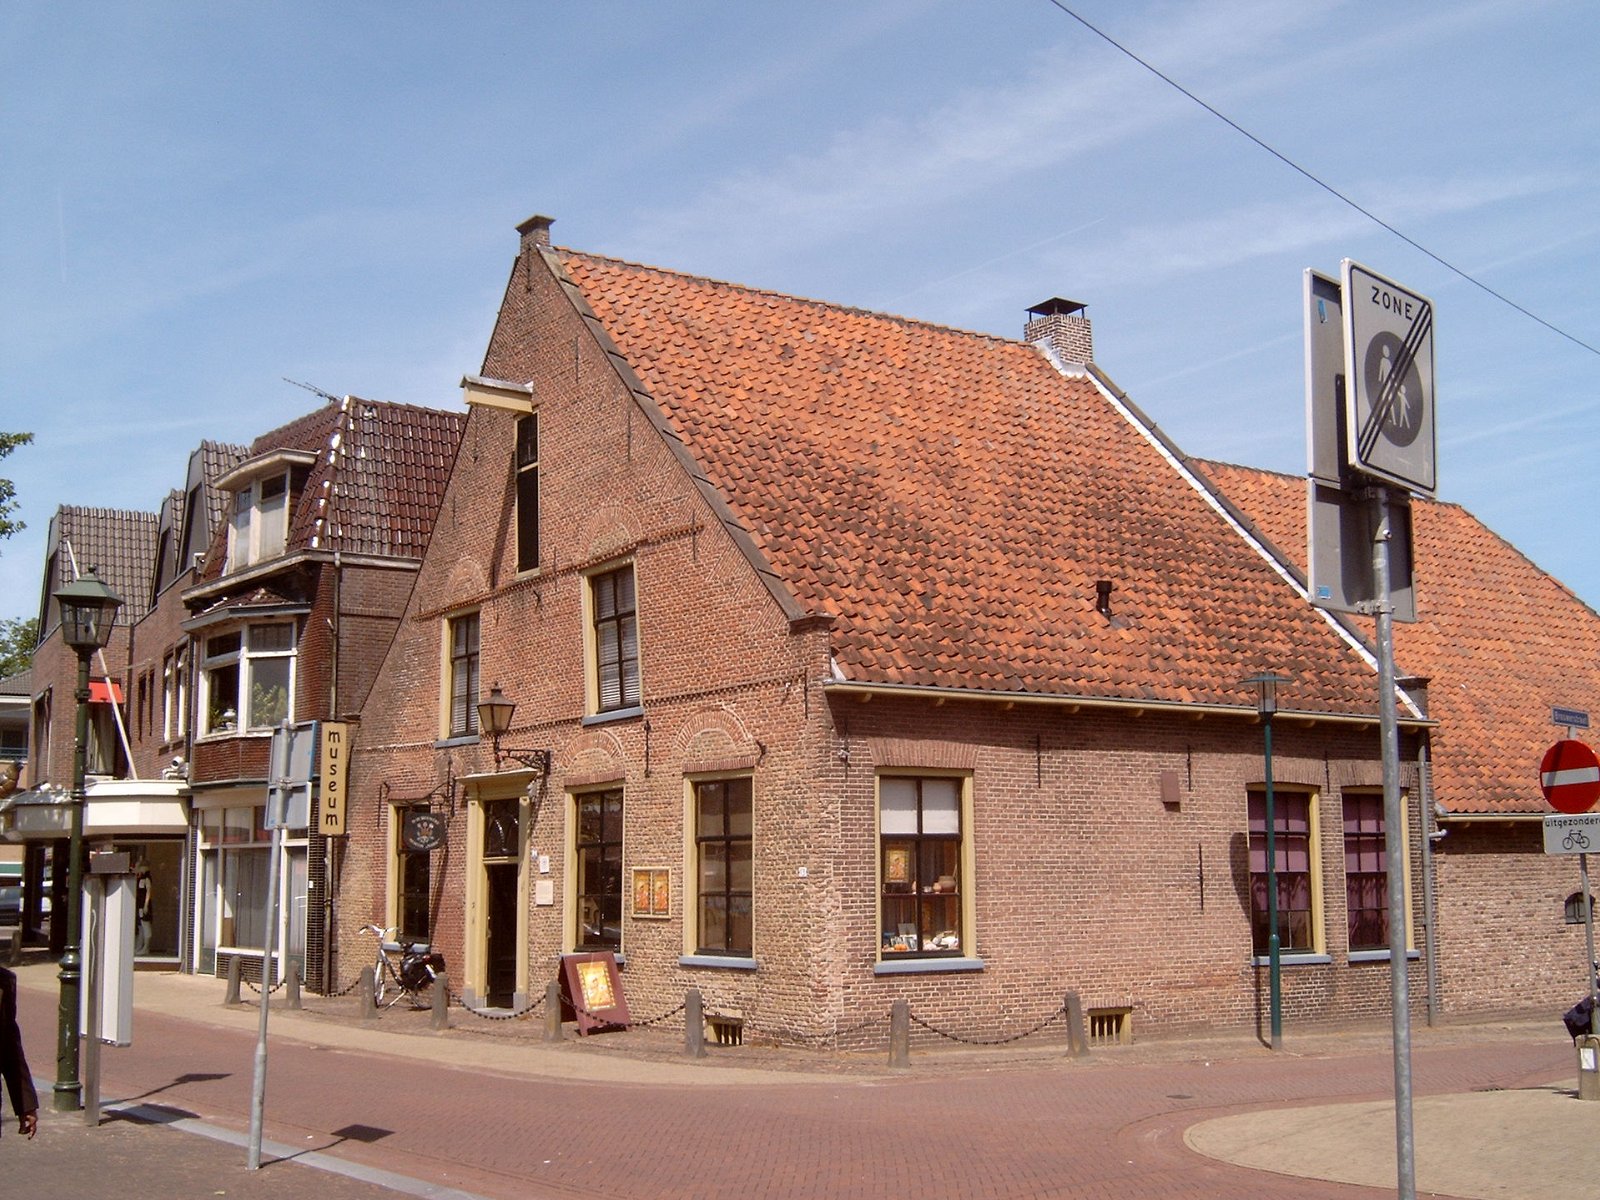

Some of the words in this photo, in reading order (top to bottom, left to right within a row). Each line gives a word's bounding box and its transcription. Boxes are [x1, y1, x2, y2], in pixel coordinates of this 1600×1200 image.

[1372, 285, 1412, 321] ZONE
[325, 730, 341, 826] museum
[1545, 817, 1600, 829] uitgezonder
